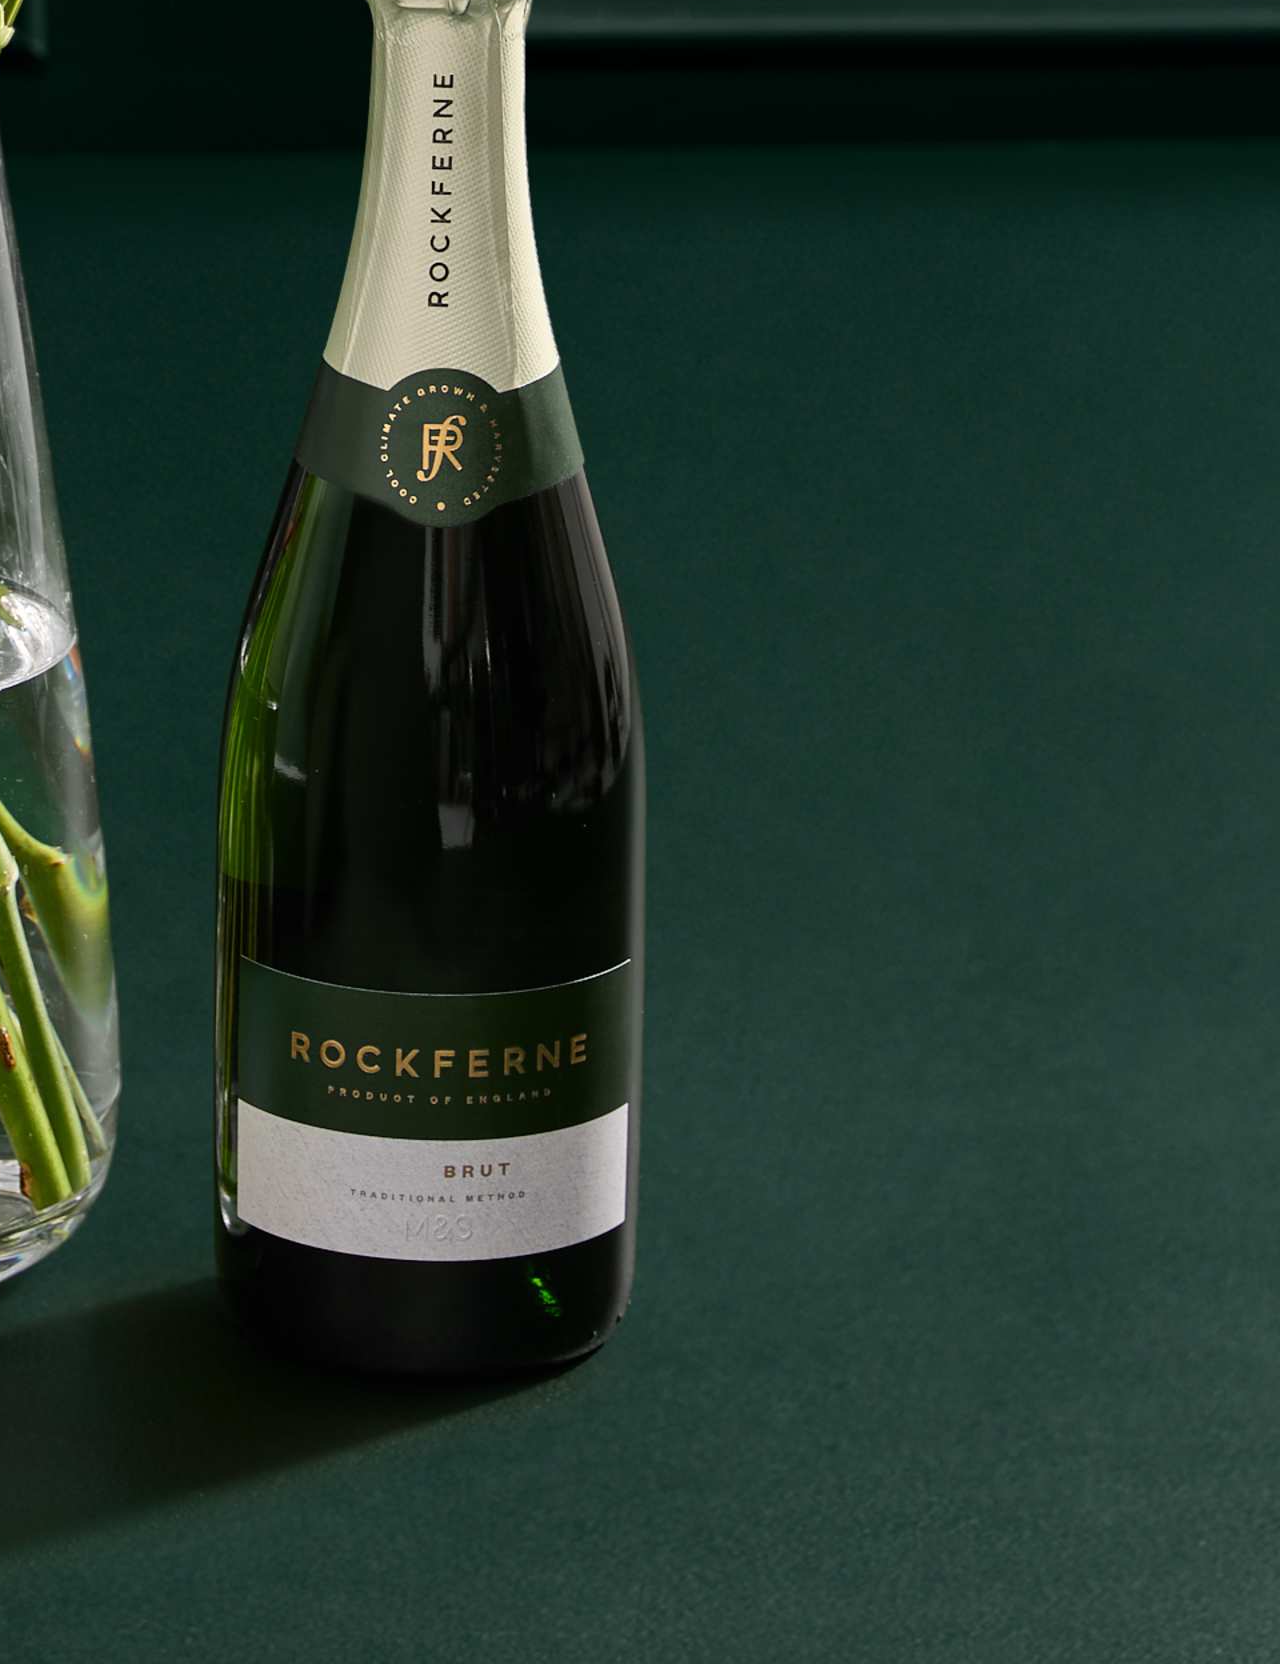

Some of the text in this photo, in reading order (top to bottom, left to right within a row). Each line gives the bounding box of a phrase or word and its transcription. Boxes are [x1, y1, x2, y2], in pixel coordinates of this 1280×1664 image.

[427, 73, 455, 309] ROCKFERNE
[416, 384, 476, 403] GROWN
[380, 395, 412, 463] CLIMATE
[385, 468, 418, 505] COOL
[290, 1030, 588, 1079] ROCKFERNE
[327, 1084, 552, 1106] PRODUCT OF ENGLAND
[443, 1161, 511, 1179] BRUT
[349, 1187, 526, 1204] TRADITIONAL METHOD
[406, 1213, 474, 1242] M&S
